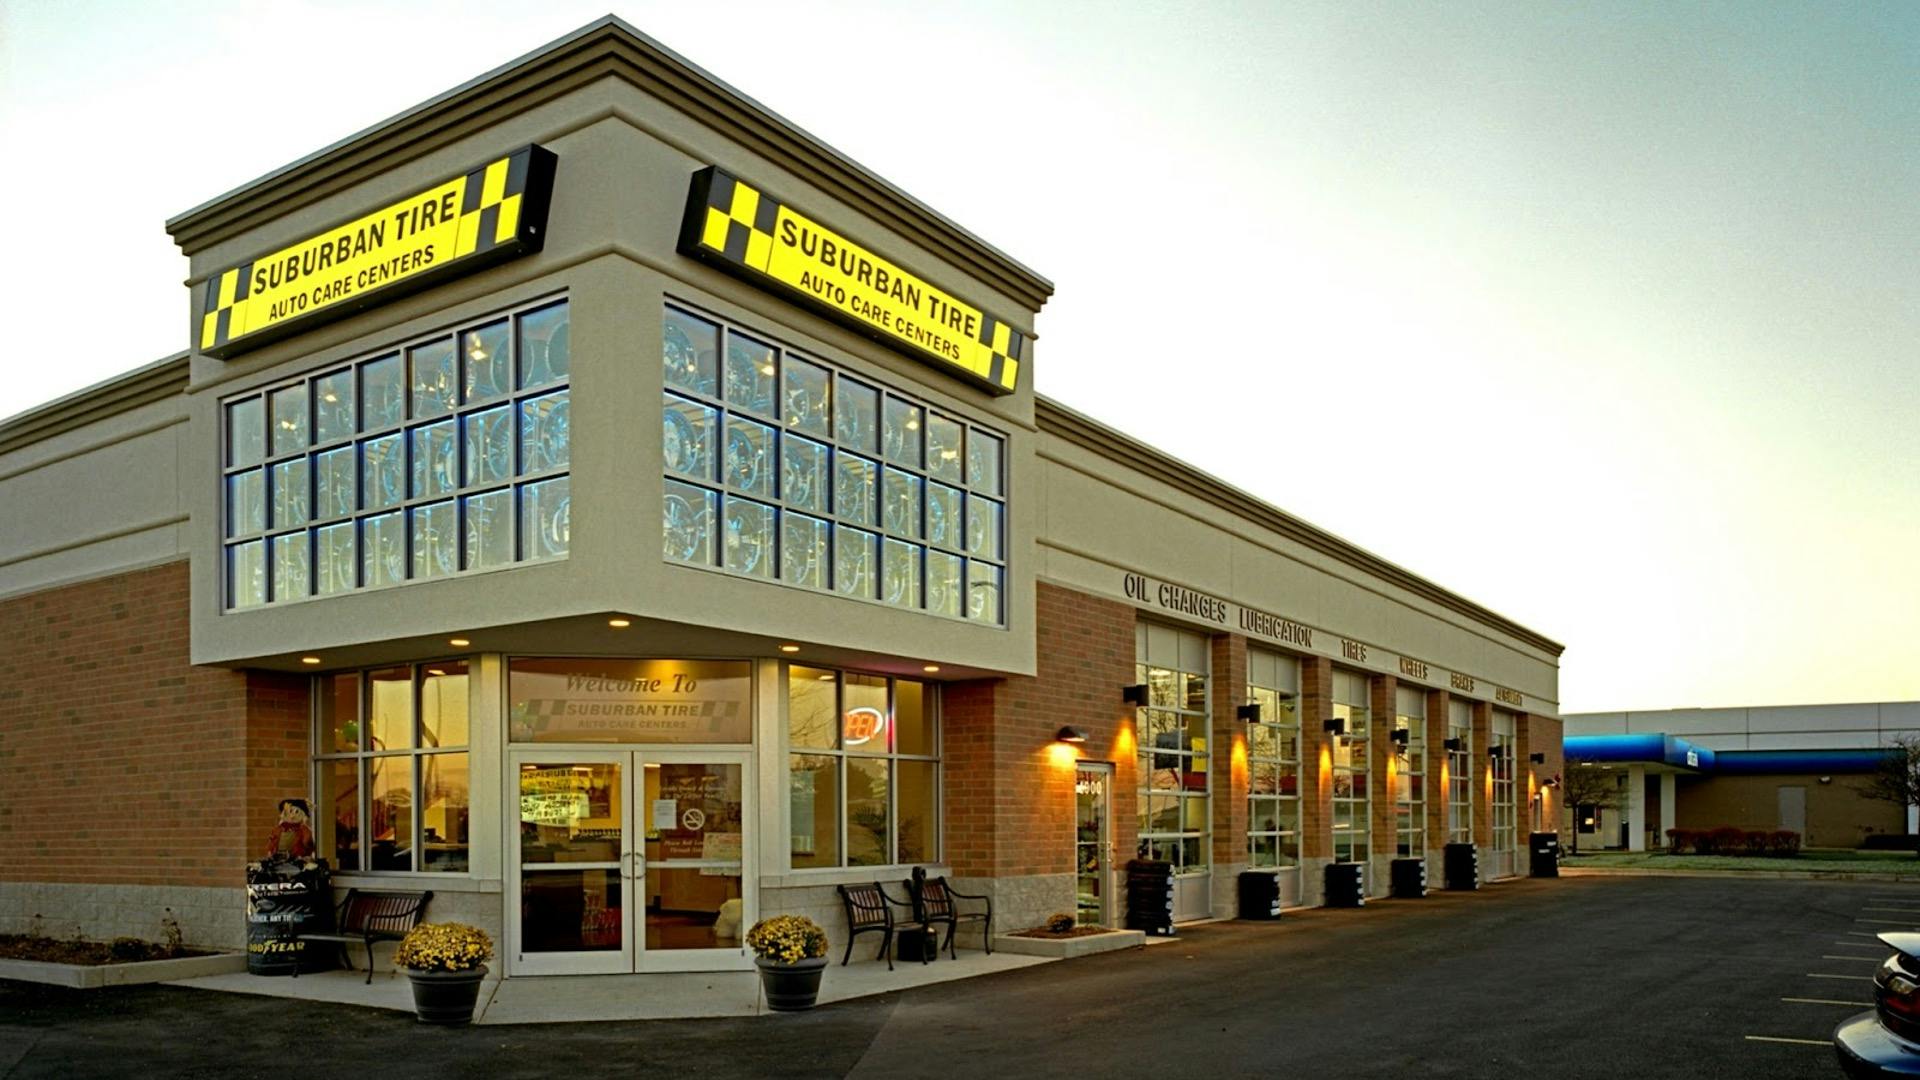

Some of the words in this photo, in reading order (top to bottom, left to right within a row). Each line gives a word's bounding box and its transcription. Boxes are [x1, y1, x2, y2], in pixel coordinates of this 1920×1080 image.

[254, 219, 386, 295] SUBURBAN
[396, 191, 456, 240] TIRE
[269, 292, 307, 321] AUTO
[313, 276, 351, 304] CARE
[357, 244, 434, 287] CENTERS
[780, 219, 920, 311] SUBURBAN
[929, 290, 976, 339] TIRE
[800, 271, 845, 305] AUTO
[851, 295, 890, 325] CARE
[896, 317, 960, 360] CENTERS
[1124, 573, 1151, 602] OIL
[1159, 583, 1226, 623] CHANGES
[1240, 608, 1312, 648] LUBRICATION
[1342, 639, 1367, 662] TIRES
[1399, 656, 1428, 680] WHEELS
[567, 672, 661, 693] Welcome
[672, 673, 697, 693] To
[566, 703, 658, 717] SUBURBAN
[661, 703, 699, 717] TIRE
[578, 720, 608, 729] AUTO
[610, 720, 637, 729] CARE
[639, 720, 687, 729] CENTERS
